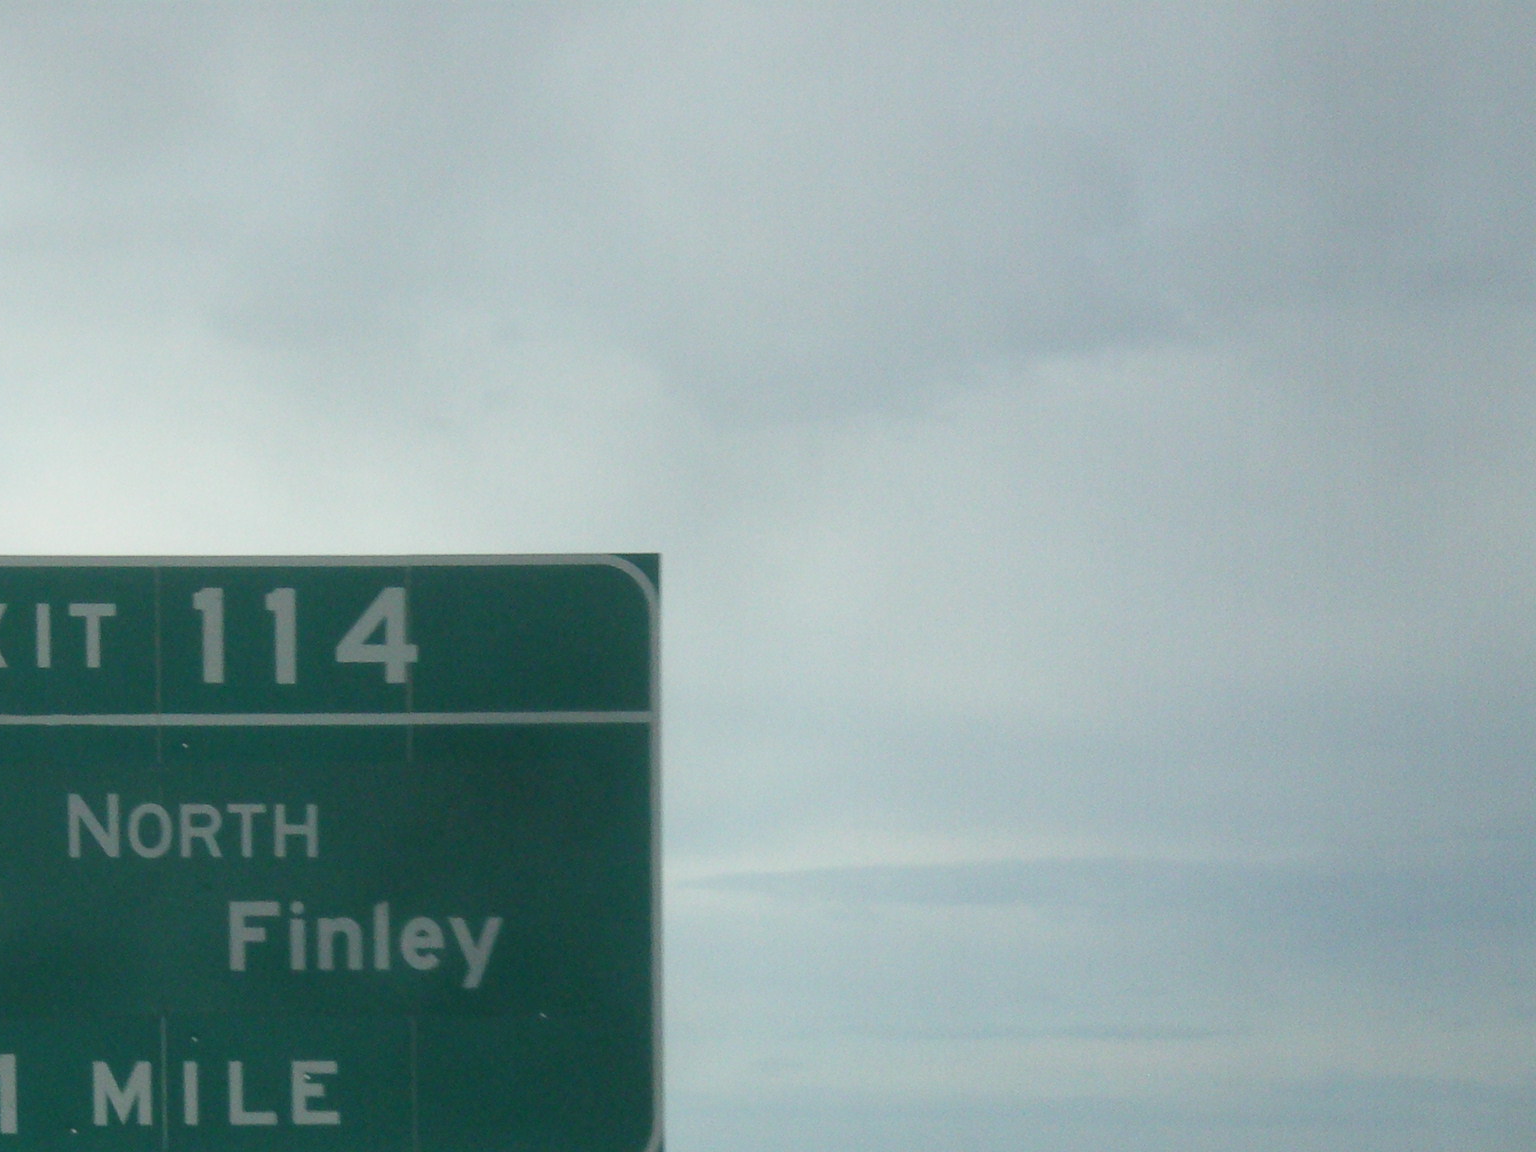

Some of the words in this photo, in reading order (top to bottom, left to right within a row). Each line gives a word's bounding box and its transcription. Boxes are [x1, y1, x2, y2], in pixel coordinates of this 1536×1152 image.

[192, 586, 419, 685] 114
[67, 793, 319, 859] NORTH
[227, 899, 502, 989] Finley
[92, 1060, 341, 1127] MILE
